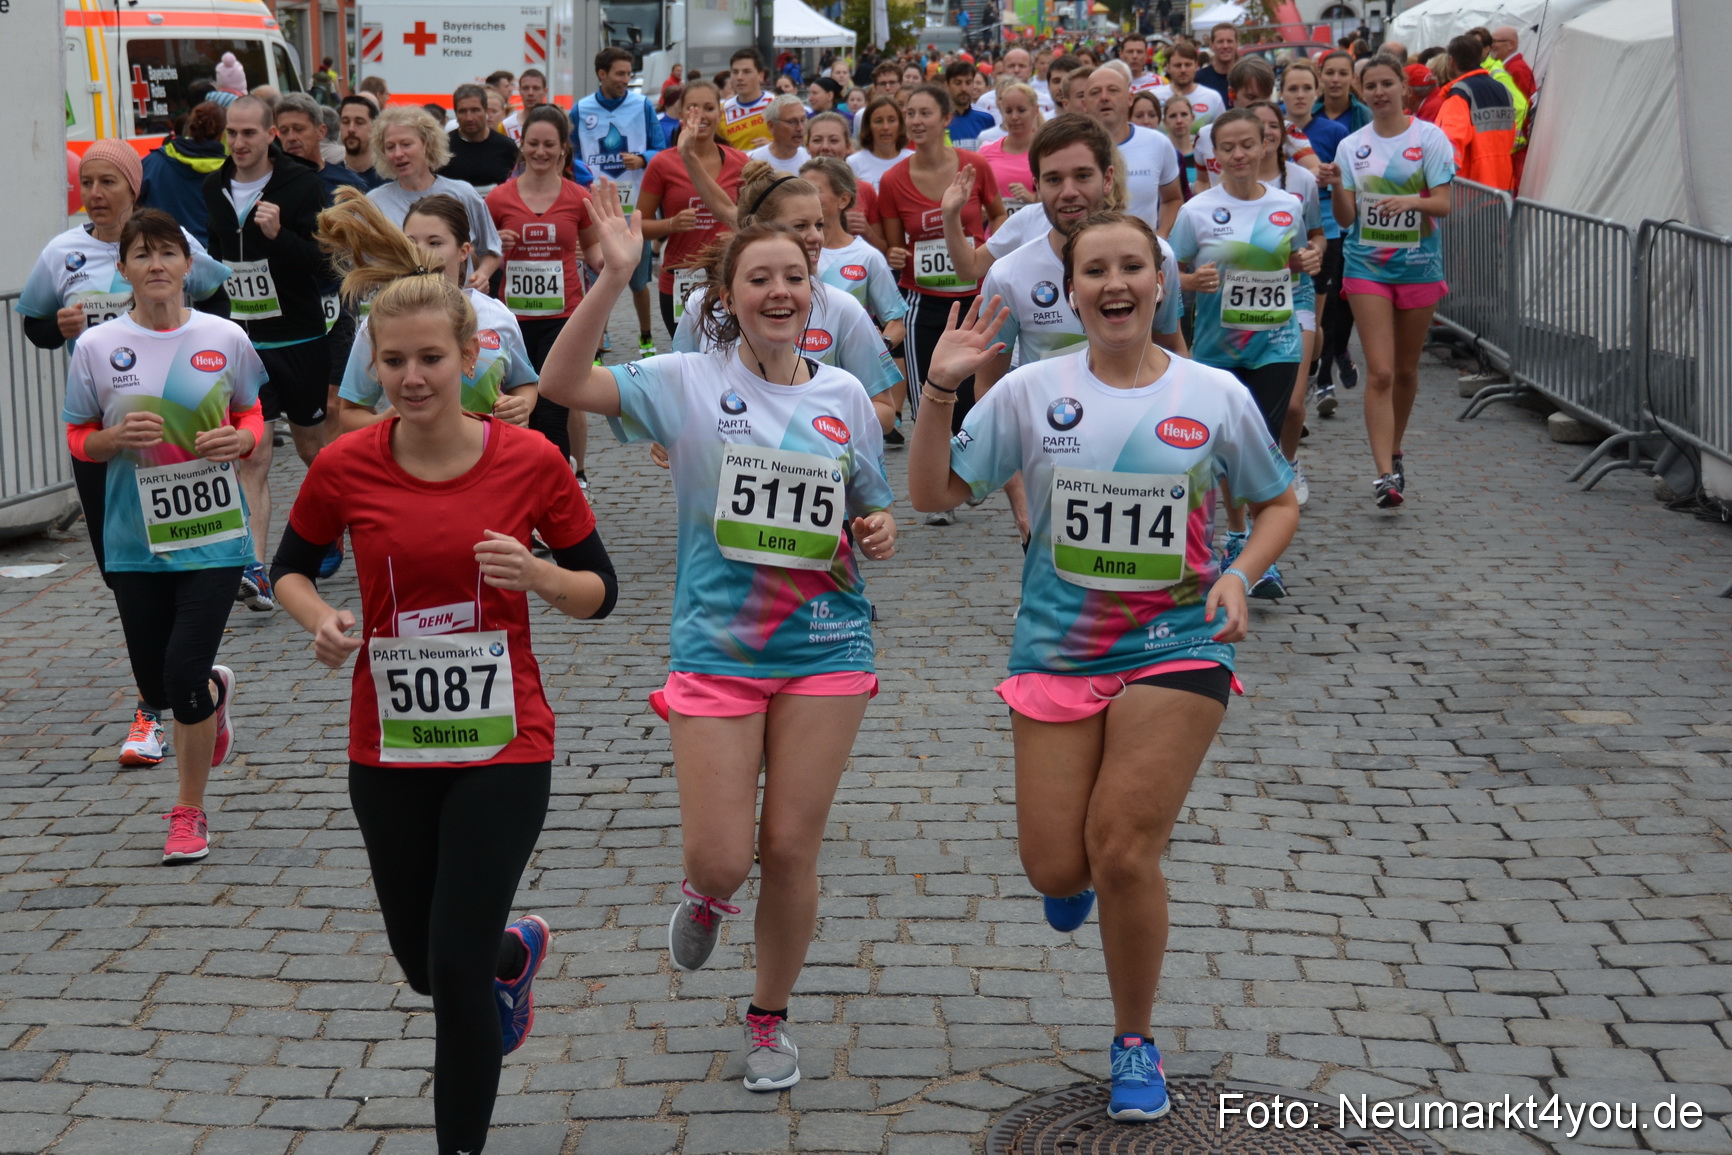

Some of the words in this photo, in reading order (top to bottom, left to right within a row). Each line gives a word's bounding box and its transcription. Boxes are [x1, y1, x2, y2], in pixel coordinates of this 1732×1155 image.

[443, 21, 506, 32] Bayerisches
[443, 35, 472, 44] Rotes
[777, 36, 820, 45] Laufsport
[443, 49, 472, 58] Kreuz
[150, 82, 166, 98] Rotes
[585, 114, 598, 130] 9
[727, 122, 748, 136] MAX
[1371, 232, 1408, 241] Elisabeth
[844, 264, 865, 277] Hervis
[226, 275, 270, 297] 5119
[511, 275, 559, 295] 5084
[1226, 274, 1250, 283] PARTL
[1251, 276, 1282, 284] Neumarkt
[1229, 285, 1286, 307] 5136
[235, 302, 268, 312] Alexander
[524, 300, 543, 309] Julia
[1033, 311, 1063, 321] PARTL
[1239, 313, 1275, 323] Claudia
[195, 355, 223, 367] Hervis
[112, 374, 139, 383] PARTL
[113, 381, 140, 389] Neumarkt
[718, 417, 751, 429] PARTL
[817, 419, 847, 440] Hervis
[1163, 423, 1204, 442] Hervis
[1042, 436, 1081, 446] PARTL
[1042, 446, 1080, 454] Neumarkt
[726, 455, 768, 470] PARTL
[771, 461, 828, 479] Neumarkt
[140, 473, 172, 486] PARTL
[173, 465, 218, 481] Neumarkt
[1056, 479, 1099, 494] PARTL
[1102, 484, 1165, 498] Neumarkt
[151, 476, 231, 519] 5080
[731, 474, 835, 527] 5115
[169, 519, 223, 539] Krystyna
[1065, 498, 1175, 547] 5114
[757, 530, 797, 551] Lena
[1092, 556, 1137, 575] Anna
[810, 600, 835, 619] 16.
[418, 612, 454, 629] DEHN
[809, 619, 863, 631] Neumarkter
[1144, 622, 1176, 640] 16.
[373, 648, 417, 661] PARTL
[420, 646, 484, 660] Neumarkt
[386, 663, 498, 713] 5087
[412, 725, 479, 744] Sabrina
